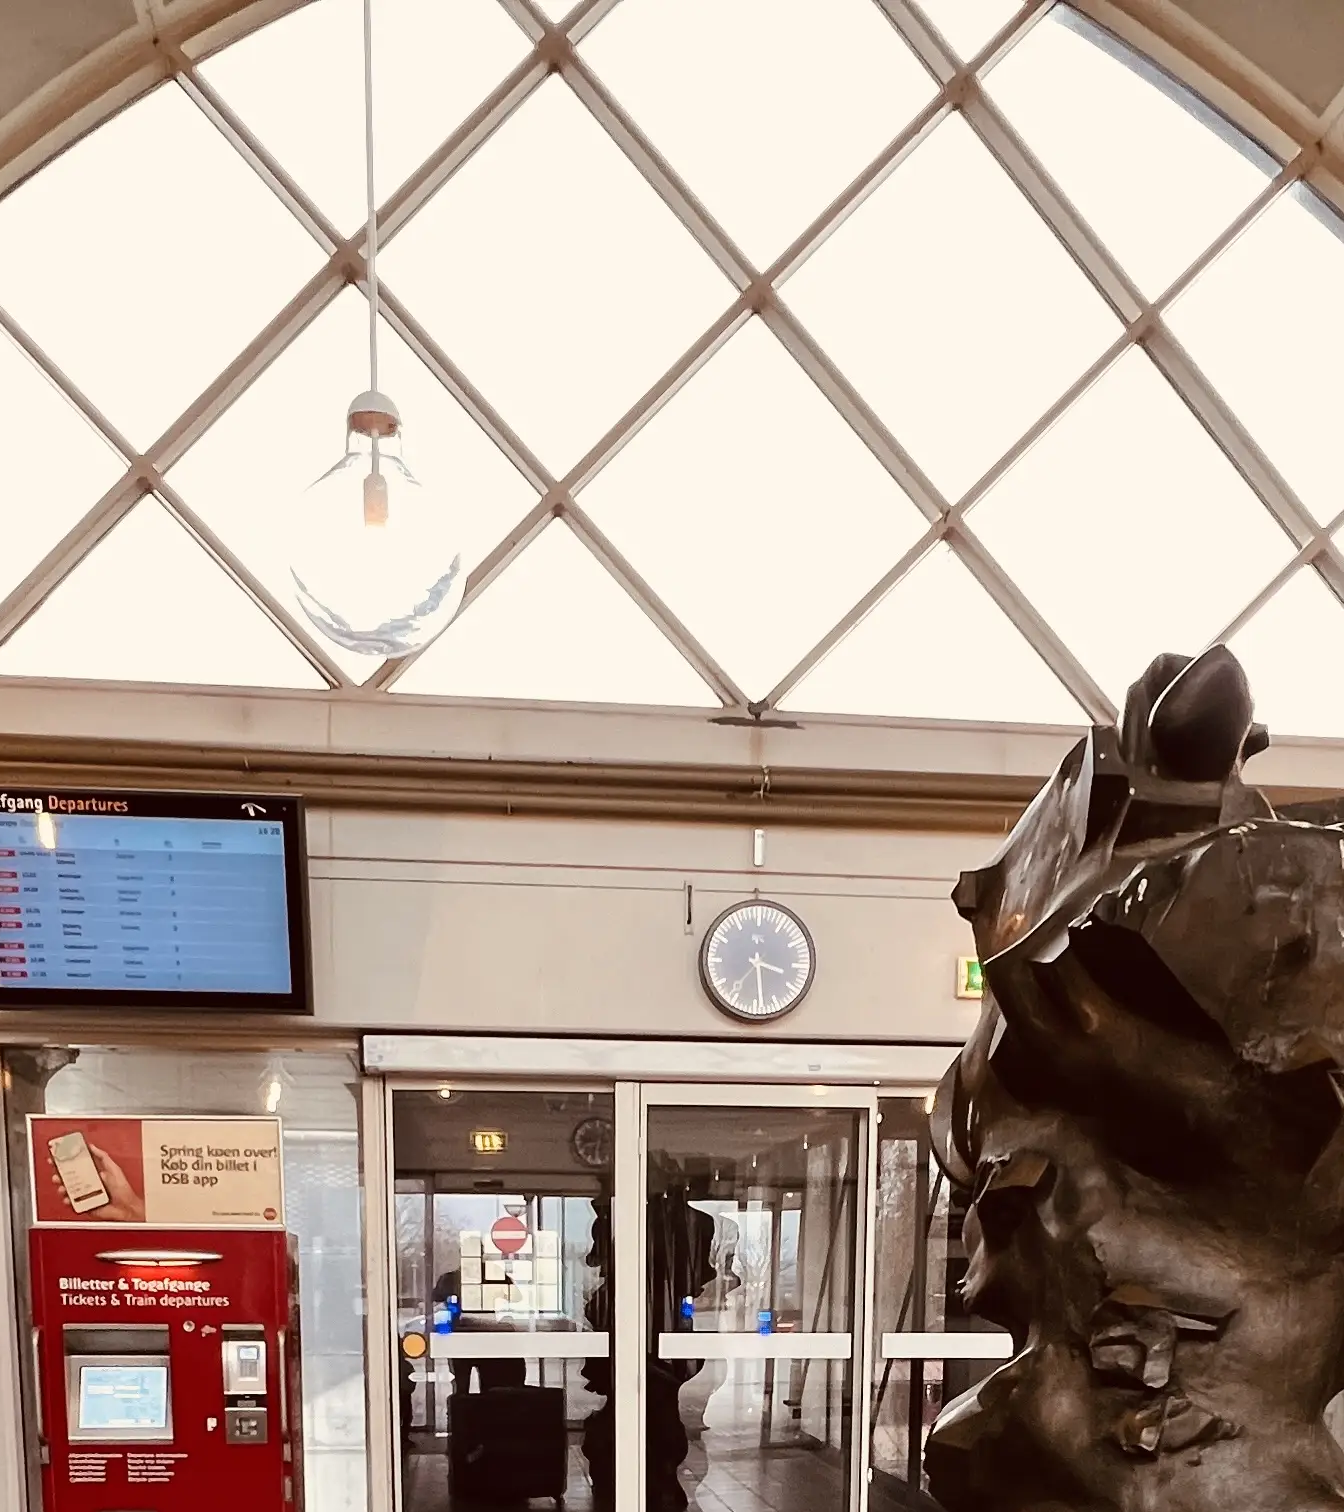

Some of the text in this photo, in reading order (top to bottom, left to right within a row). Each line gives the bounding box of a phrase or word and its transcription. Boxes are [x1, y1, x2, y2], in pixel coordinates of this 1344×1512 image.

[48, 795, 129, 813] Departures
[160, 1144, 203, 1158] Spring
[244, 1147, 277, 1158] over!
[191, 1159, 212, 1171] din
[216, 1159, 249, 1172] billet
[161, 1173, 218, 1187] DSB app
[58, 1277, 211, 1293] Billetter & Togafgange
[60, 1293, 230, 1308] Tickets & Train departures
